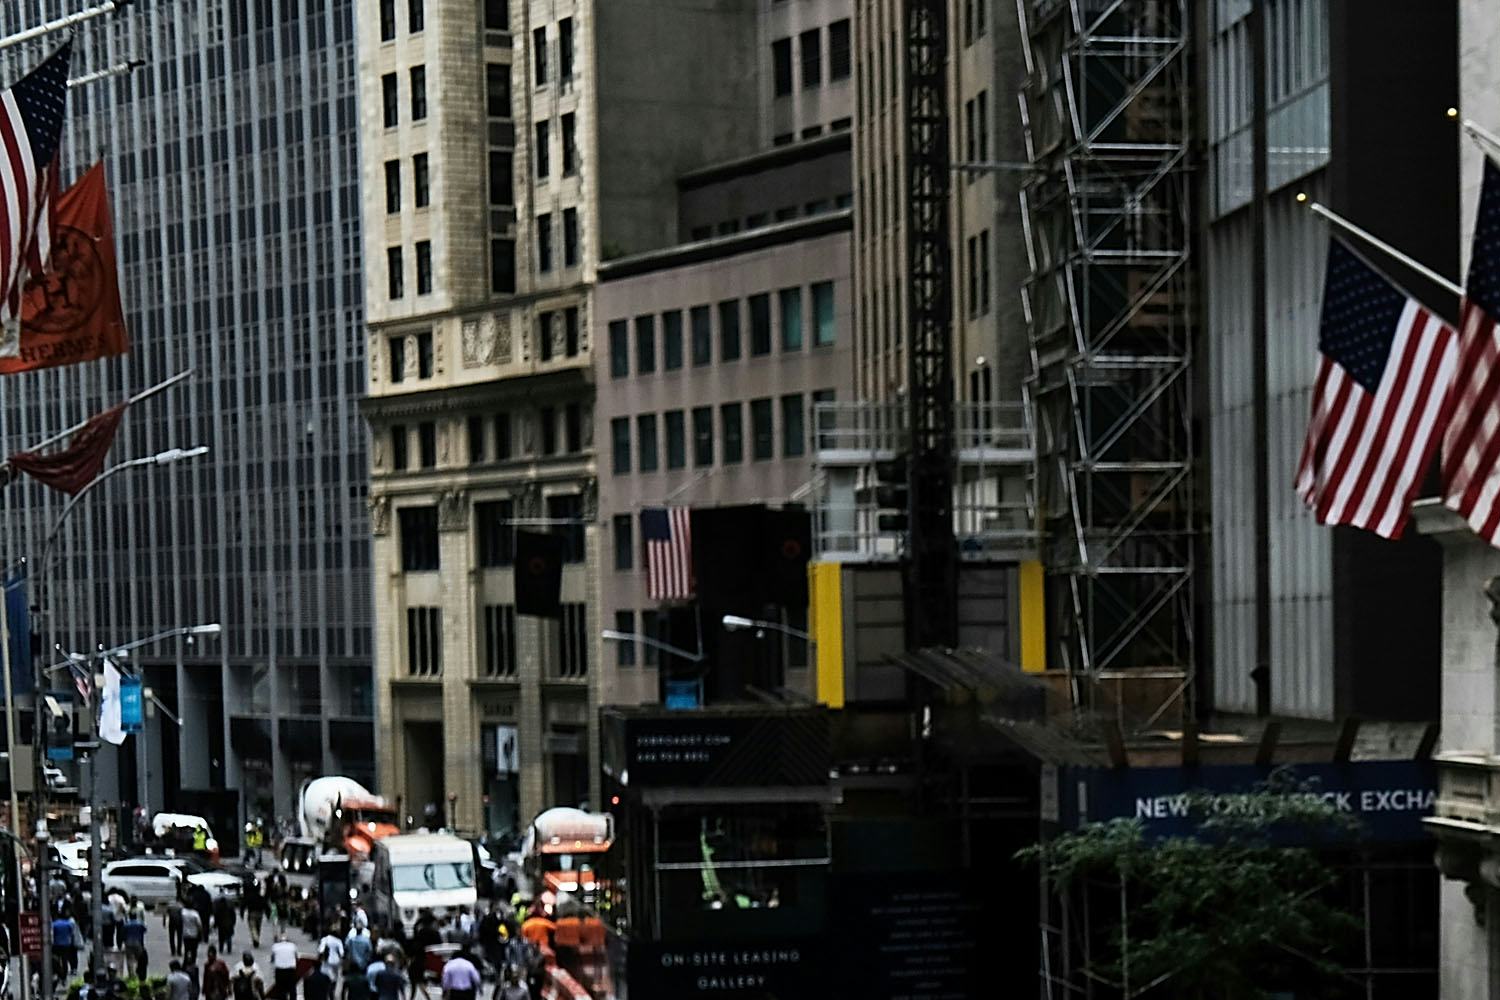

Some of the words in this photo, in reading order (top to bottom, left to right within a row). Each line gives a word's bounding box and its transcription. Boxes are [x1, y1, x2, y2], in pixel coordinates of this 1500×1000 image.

[1136, 794, 1191, 819] NEW
[661, 951, 726, 967] ON-SITE
[733, 949, 801, 965] LEASING
[696, 975, 765, 990] GALLERY
